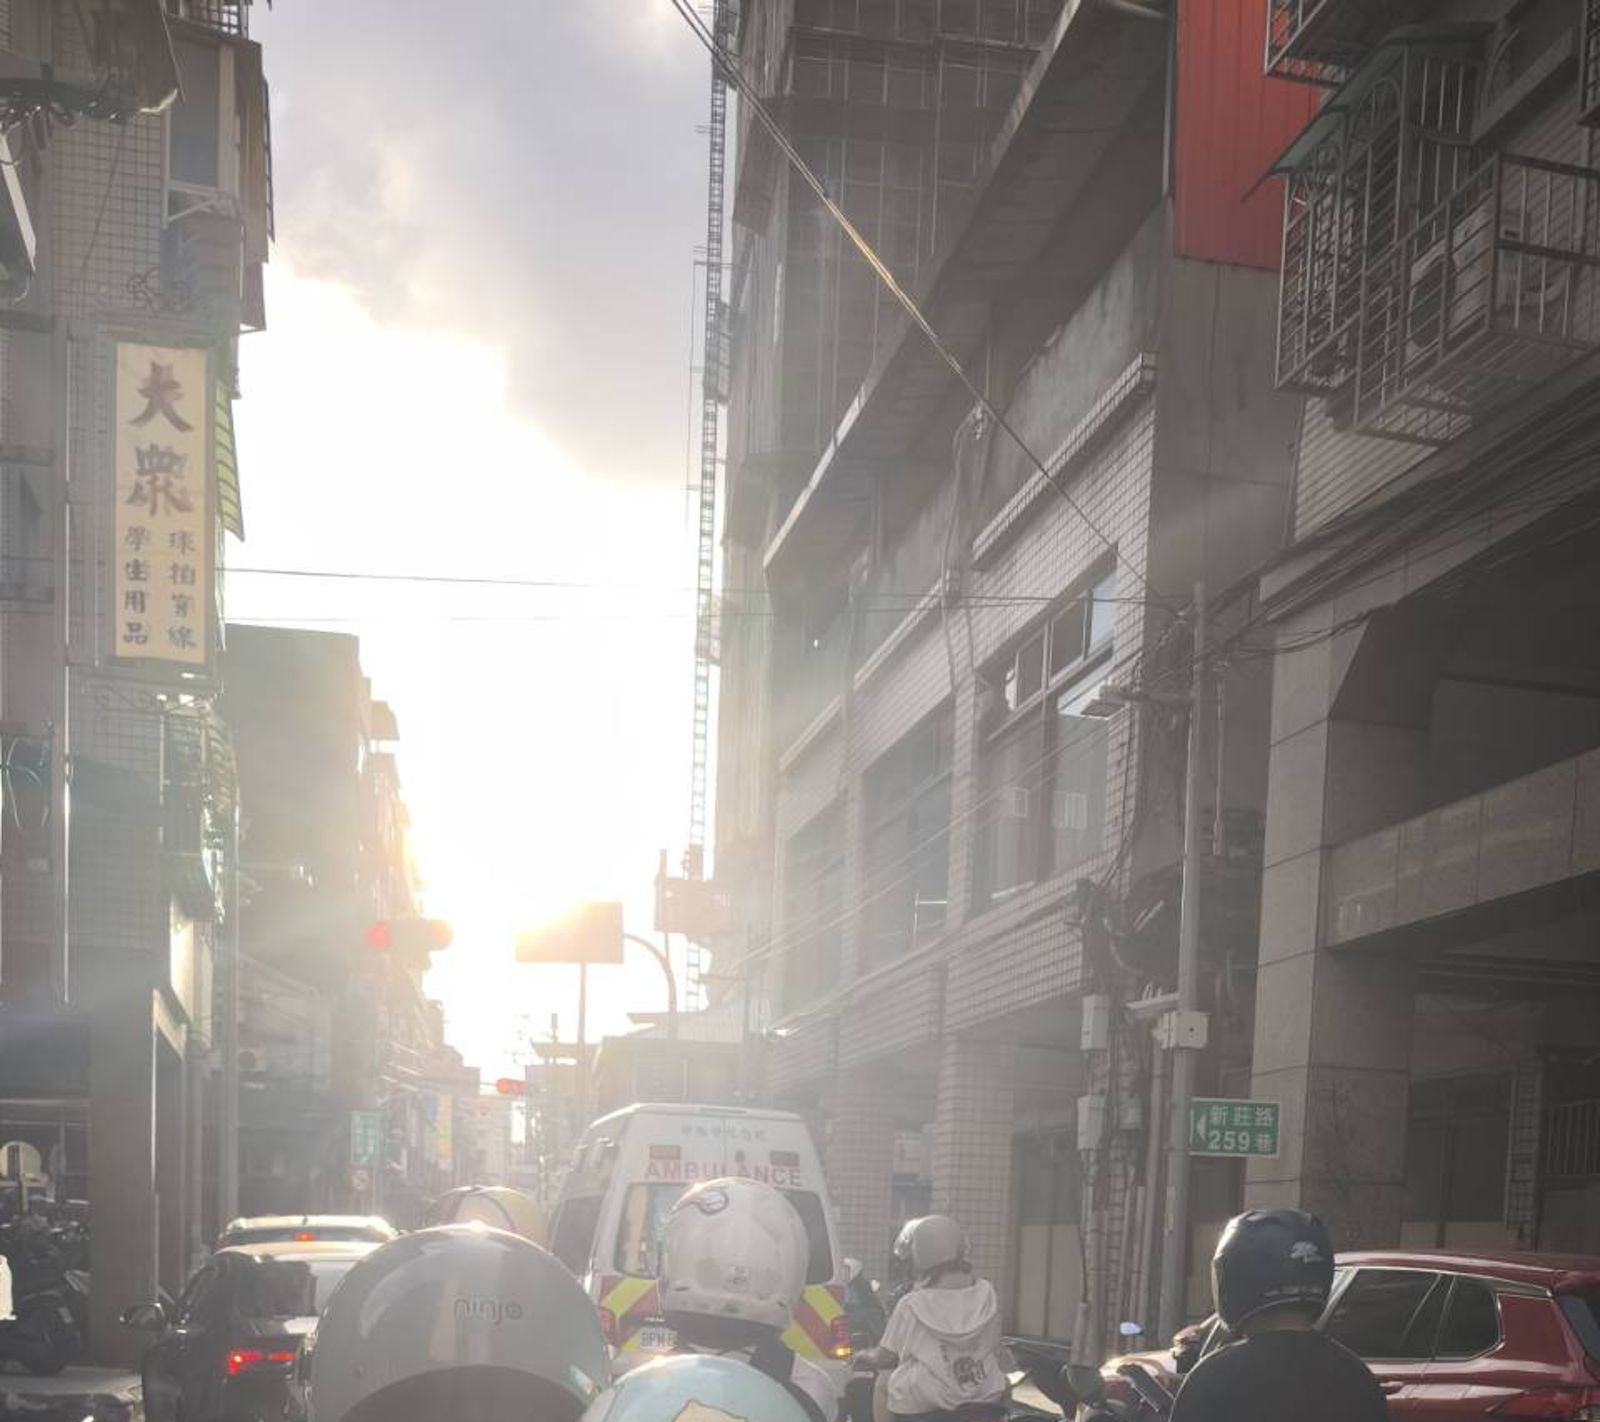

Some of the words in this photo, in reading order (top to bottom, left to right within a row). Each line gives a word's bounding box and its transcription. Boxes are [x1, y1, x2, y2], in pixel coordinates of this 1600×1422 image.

[122, 525, 151, 645] 學生用品
[1210, 1104, 1275, 1128] 新莊路
[643, 1158, 801, 1187] AMBULANCE
